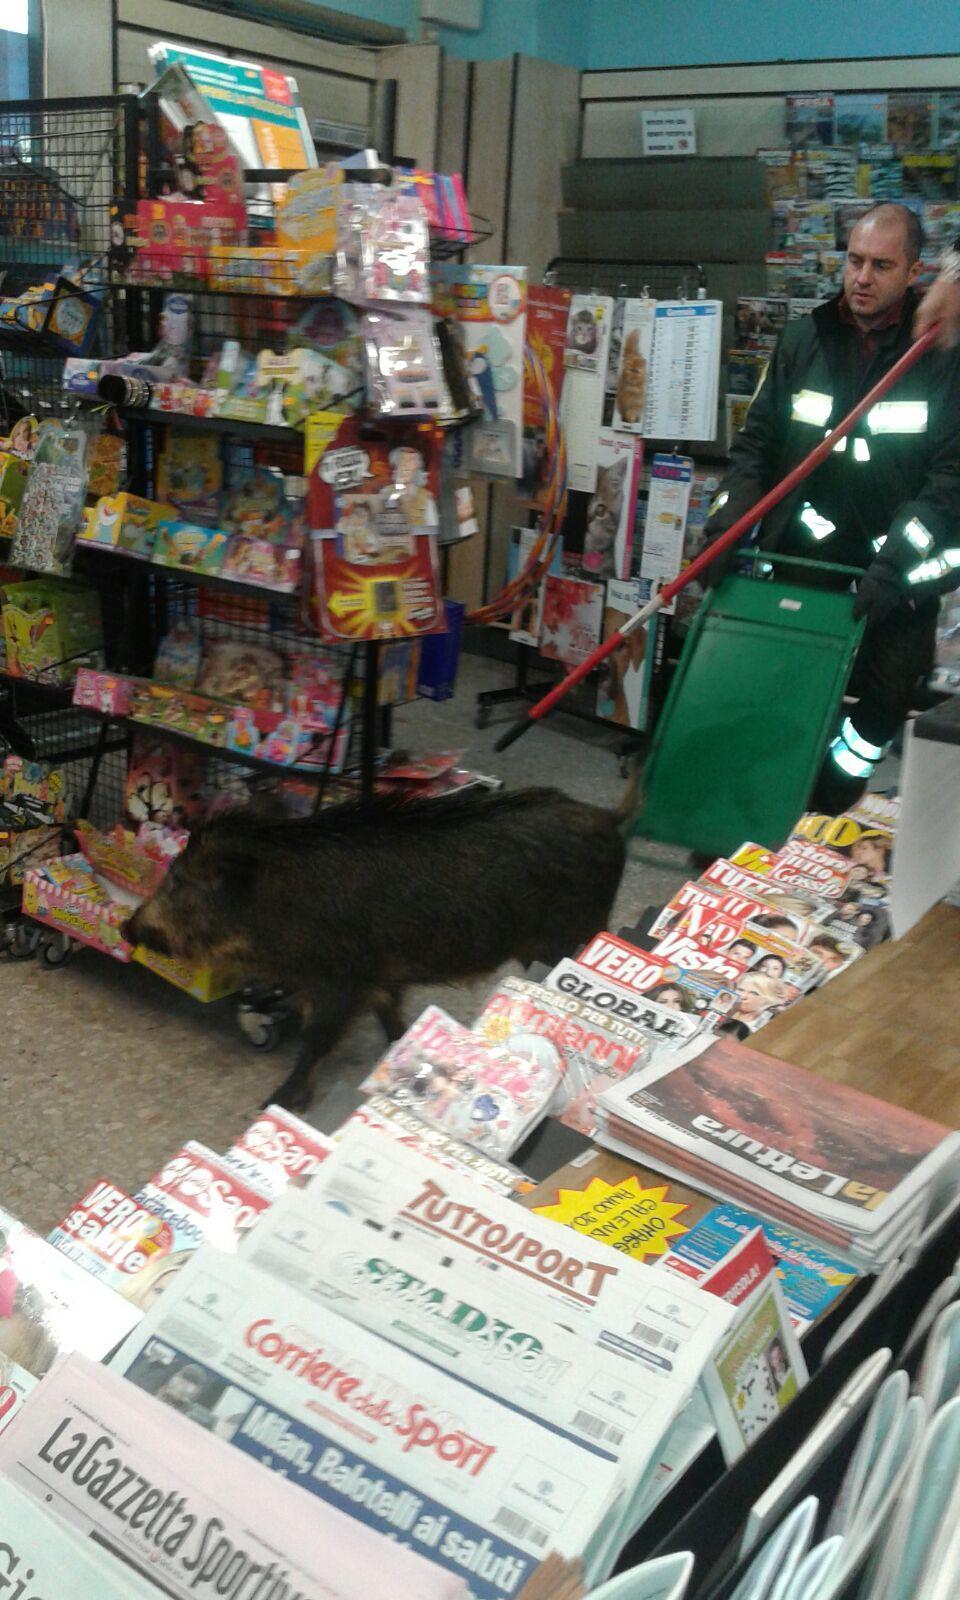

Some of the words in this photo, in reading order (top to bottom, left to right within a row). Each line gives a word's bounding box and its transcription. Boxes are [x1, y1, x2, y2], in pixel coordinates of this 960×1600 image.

[580, 943, 662, 991] VERO
[652, 934, 745, 980] Visto
[555, 972, 678, 1038] GLOBAL
[580, 1004, 610, 1029] PER
[66, 1209, 149, 1274] salute
[401, 1180, 618, 1299] TUTTOSPORT
[590, 1198, 658, 1243] CALEND
[243, 1318, 362, 1408] Corriere
[395, 1404, 498, 1477] Sport
[242, 1405, 312, 1474] Milan,
[314, 1450, 423, 1526] Balotelli
[412, 1513, 446, 1550] ai
[442, 1526, 527, 1593] saluti
[182, 1516, 313, 1600] Sportiv
